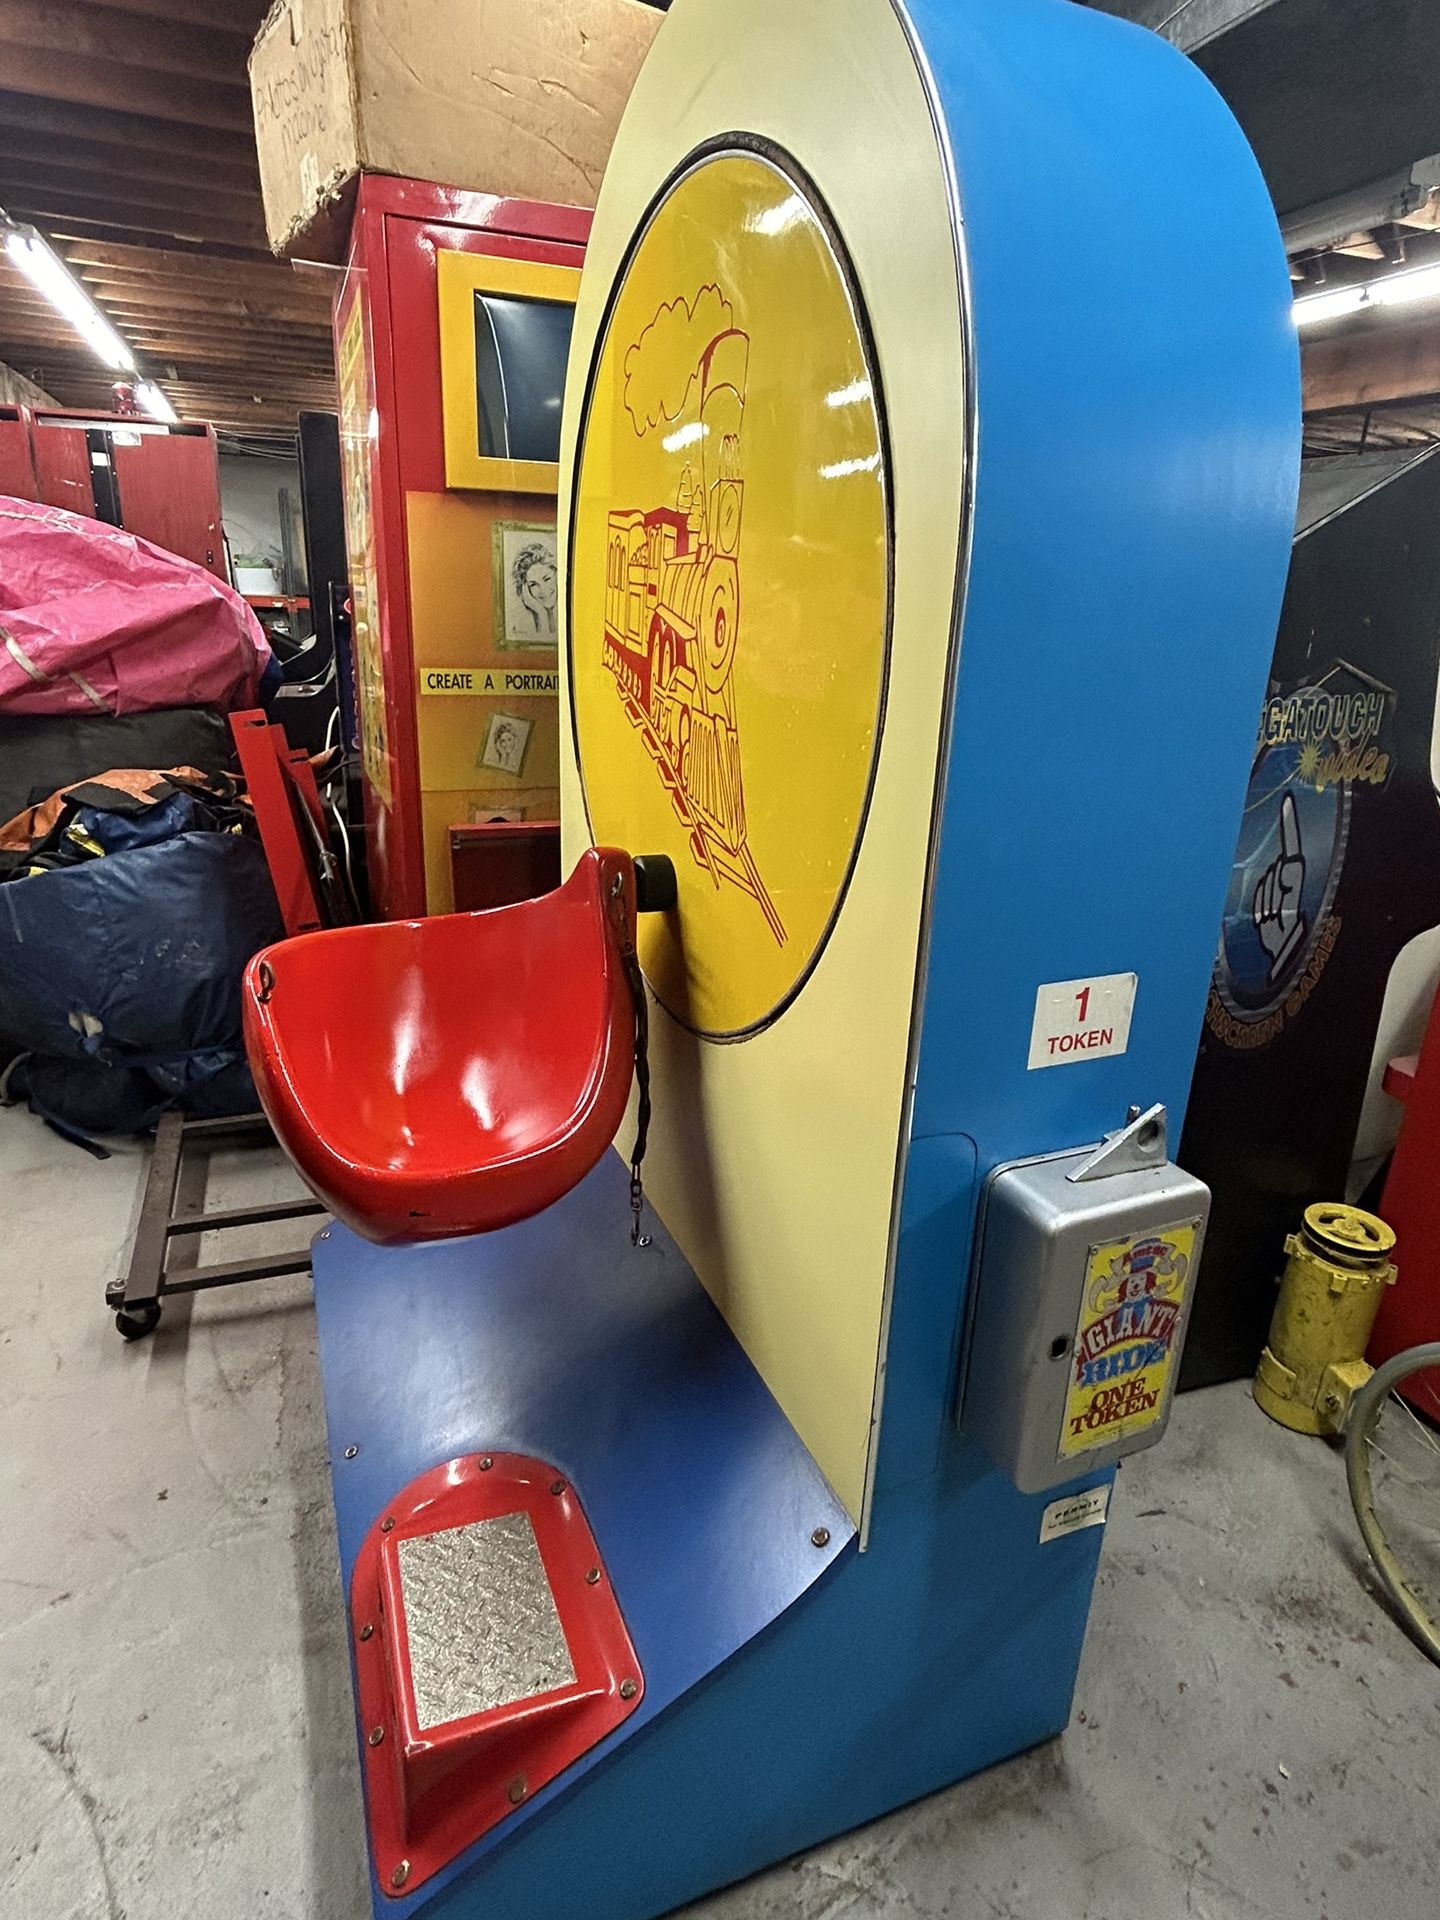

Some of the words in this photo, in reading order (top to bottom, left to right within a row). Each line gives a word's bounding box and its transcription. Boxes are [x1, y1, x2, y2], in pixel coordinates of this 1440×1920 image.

[427, 674, 472, 689] CREATE
[484, 674, 494, 690] A
[1075, 986, 1090, 1023] 1
[1047, 1027, 1114, 1055] TOKEN
[1086, 1302, 1177, 1354] GIANT
[1080, 1340, 1166, 1388] RIDE
[1070, 1388, 1161, 1436] TOKEN
[1090, 1376, 1146, 1411] ONE
